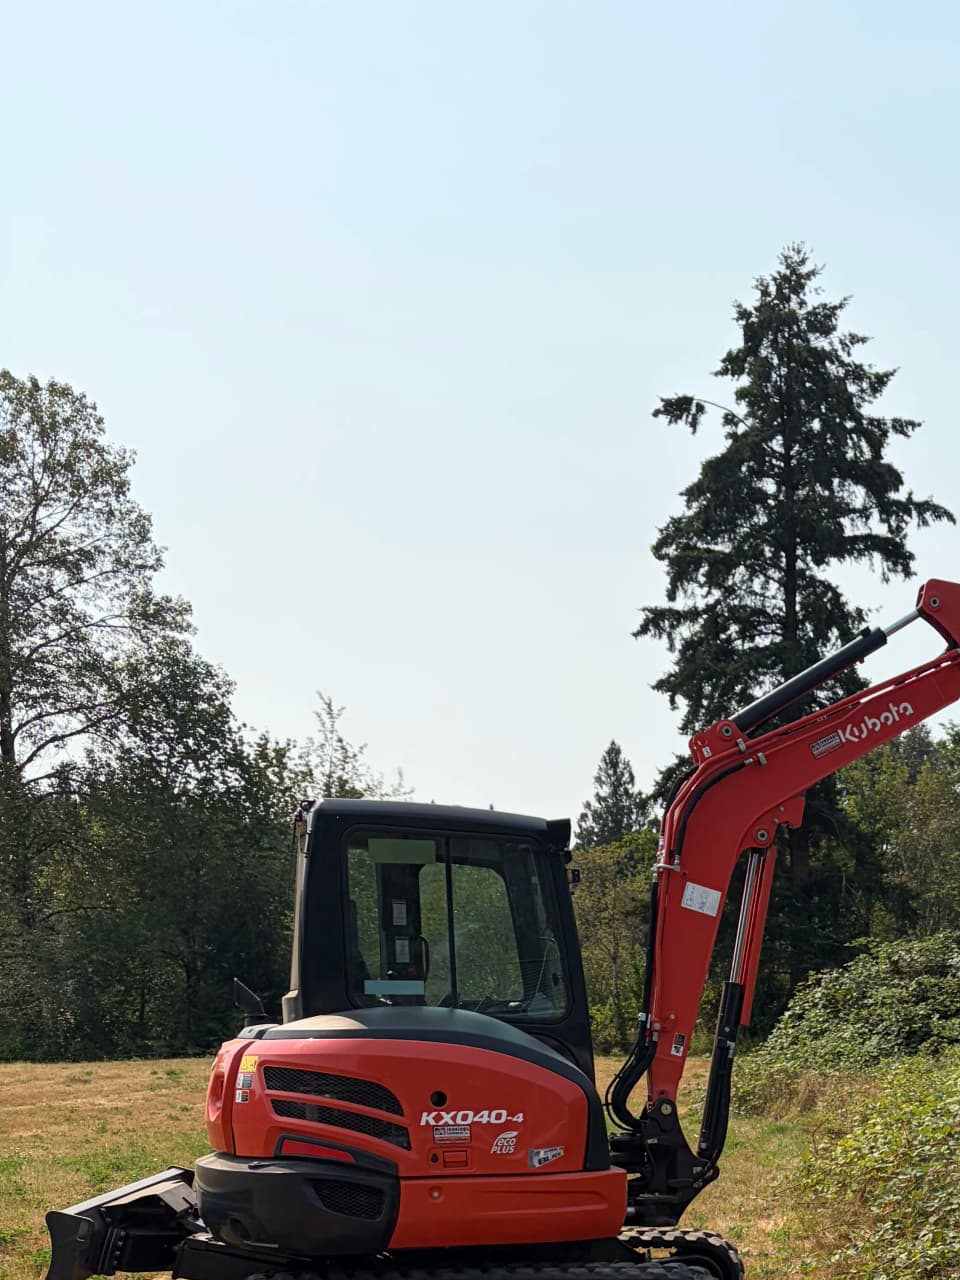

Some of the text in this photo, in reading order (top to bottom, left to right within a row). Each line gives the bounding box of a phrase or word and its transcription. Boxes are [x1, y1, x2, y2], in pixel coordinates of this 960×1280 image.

[838, 702, 913, 743] Kubota
[420, 1110, 524, 1125] KX040-4
[490, 1145, 516, 1154] PLUS
